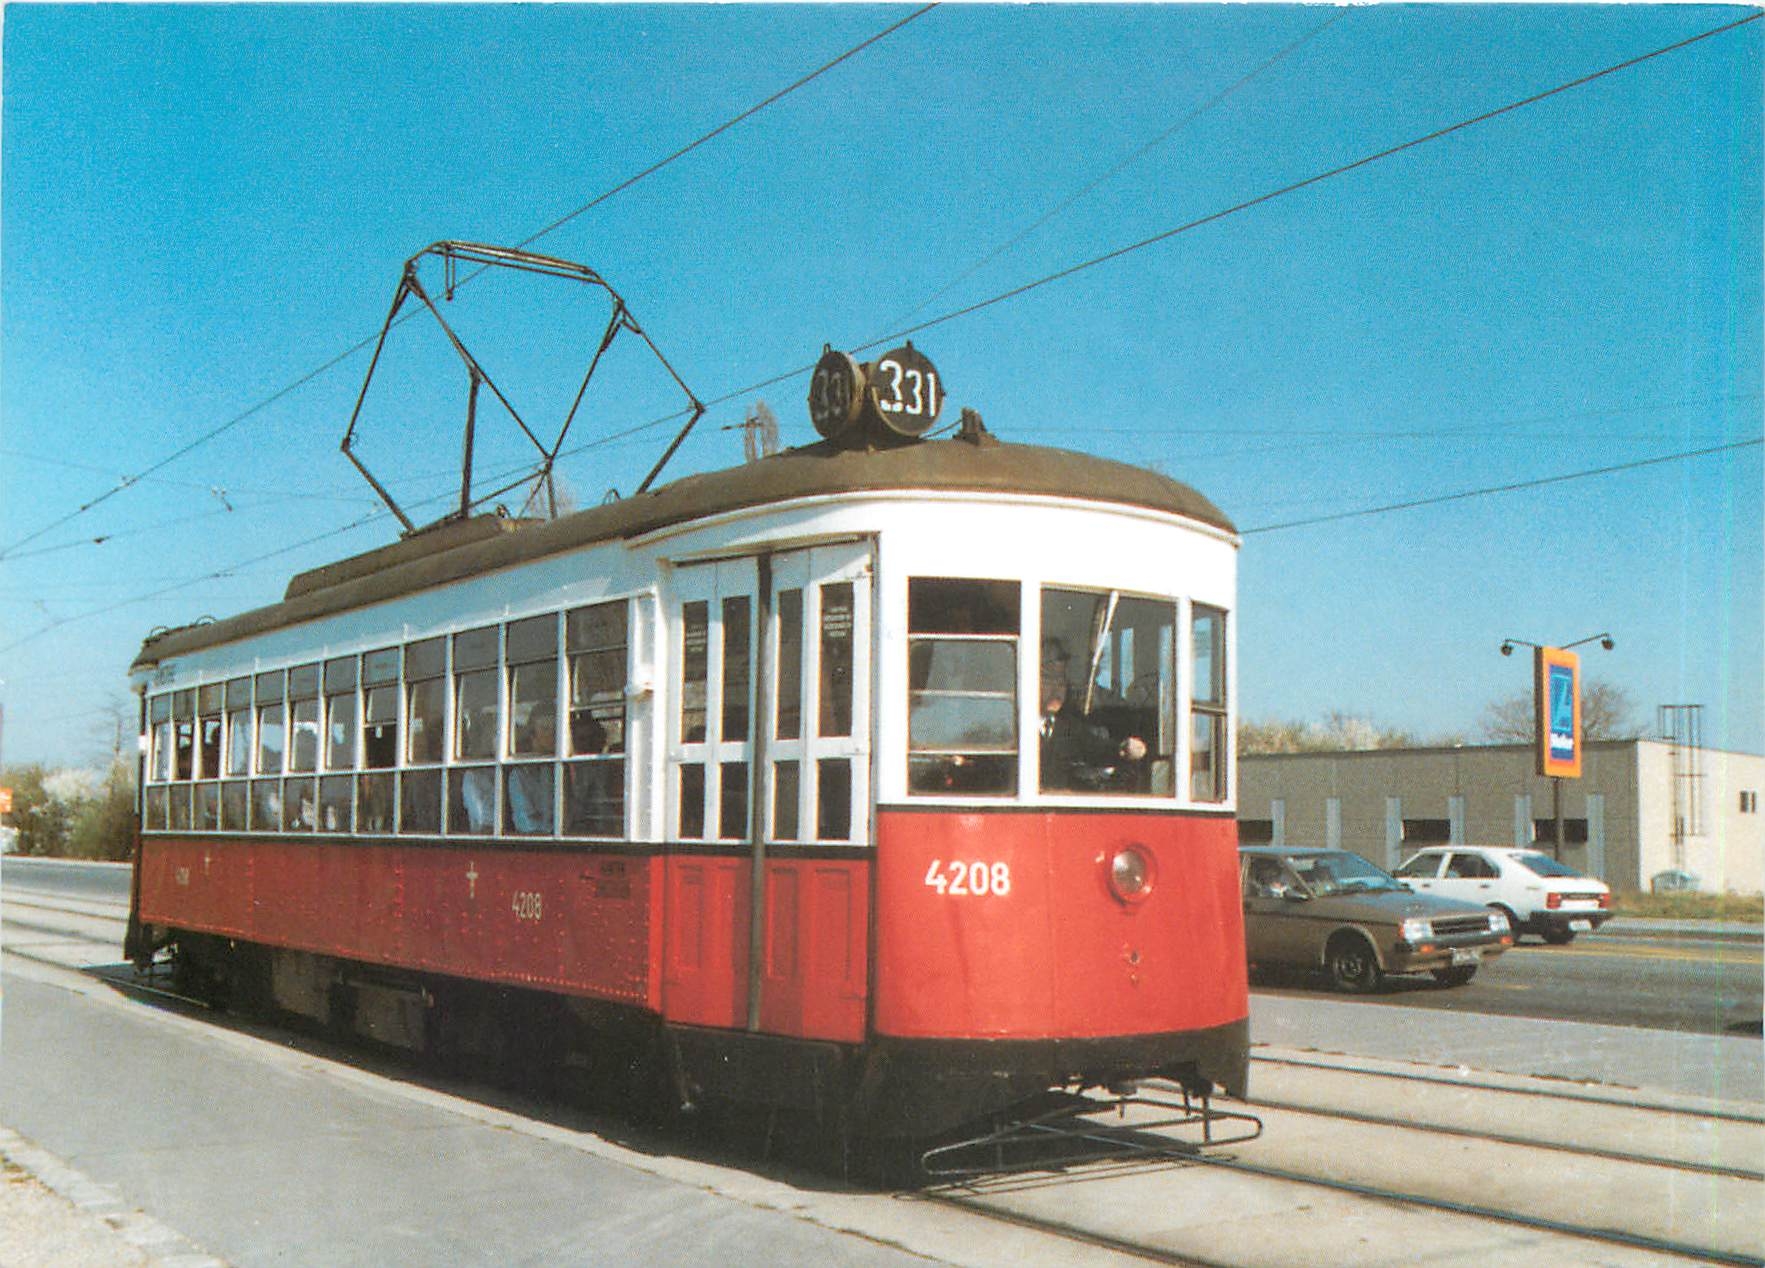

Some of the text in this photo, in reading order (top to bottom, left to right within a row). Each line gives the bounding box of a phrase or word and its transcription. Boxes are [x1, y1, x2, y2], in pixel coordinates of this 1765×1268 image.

[880, 359, 937, 417] 331
[924, 859, 1011, 896] 4208
[511, 890, 542, 920] 4208
